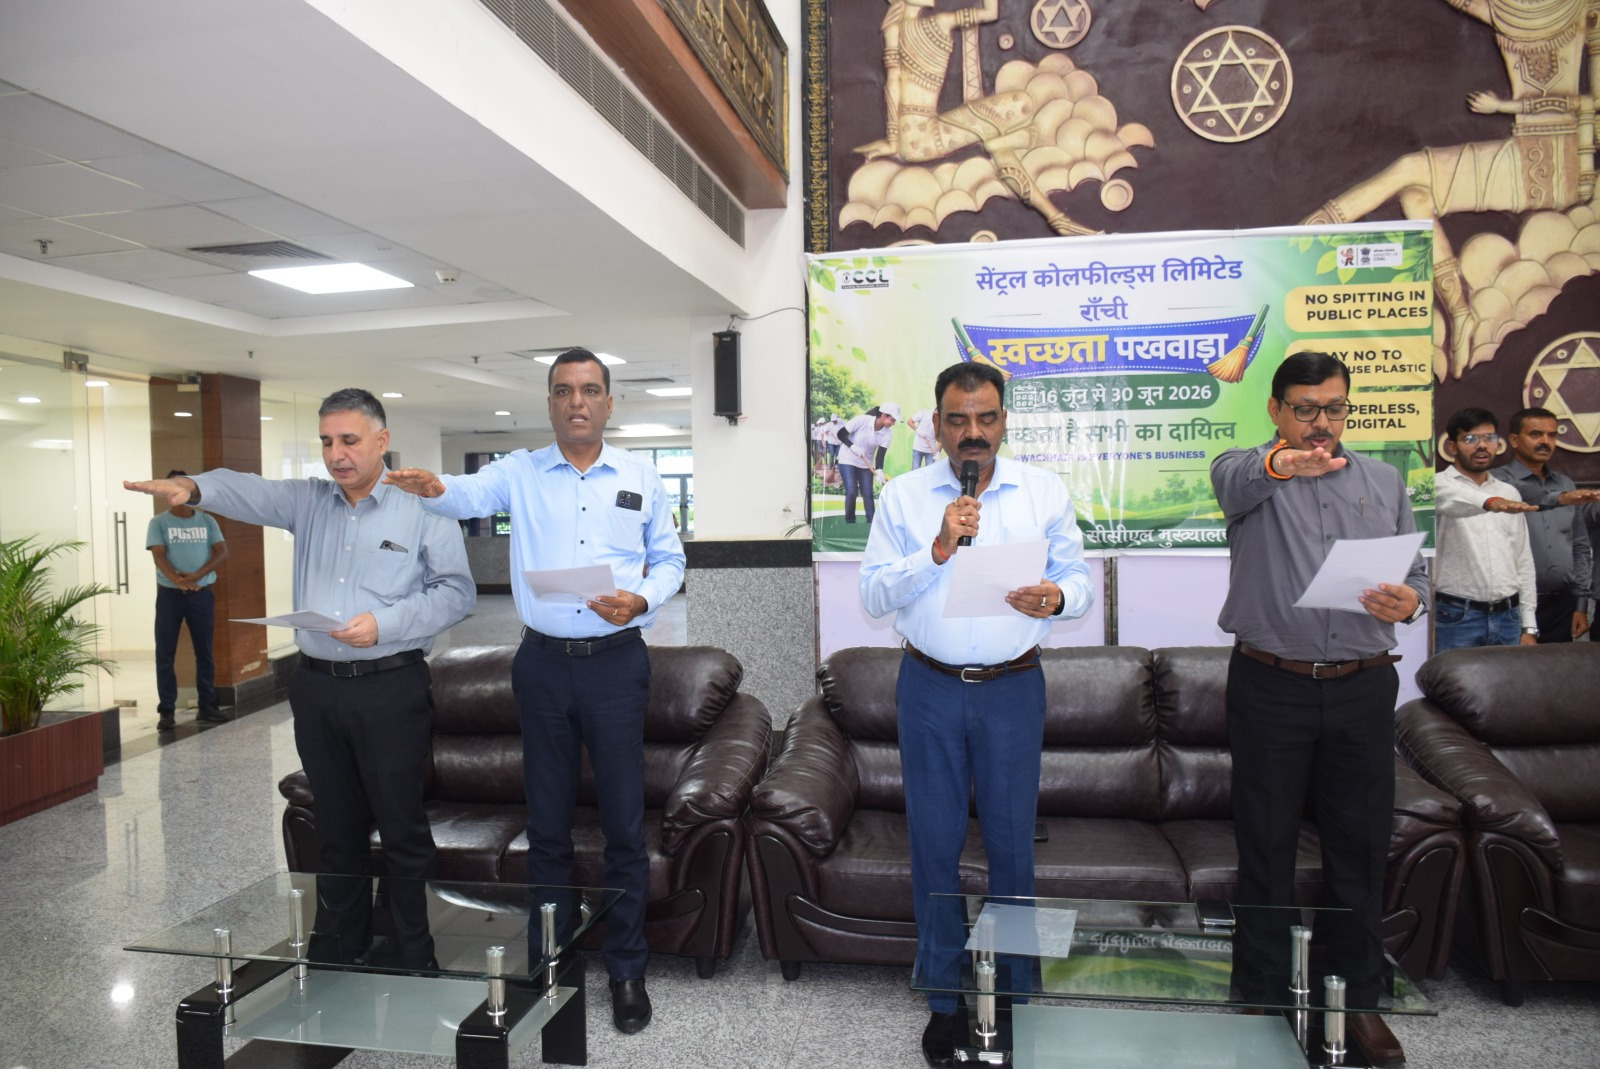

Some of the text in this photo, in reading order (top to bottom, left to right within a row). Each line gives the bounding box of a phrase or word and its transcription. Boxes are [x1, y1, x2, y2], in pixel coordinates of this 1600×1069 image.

[853, 270, 889, 284] CCL
[976, 255, 1243, 295] सेंट्रल कोलफील्ड्स लिमिटेड
[1305, 290, 1425, 305] NO SPITTING IN
[1079, 296, 1129, 321] राँची
[1307, 306, 1428, 321] PUBLIC PLACES
[987, 333, 1229, 365] स्वच्छता पखवाड़ा
[1331, 350, 1402, 361] AY NO TO
[1375, 364, 1427, 374] PLASTIC
[1039, 383, 1212, 408] 16 जून से 30 जून 2026
[1349, 403, 1420, 415] PERLESS,
[1134, 422, 1163, 442] का
[1168, 417, 1237, 442] दायित्व
[1346, 418, 1406, 429] DIGITAL
[1155, 450, 1206, 460] BUSINESS
[168, 527, 208, 540] PUMA
[1086, 524, 1154, 544] सीसीएल
